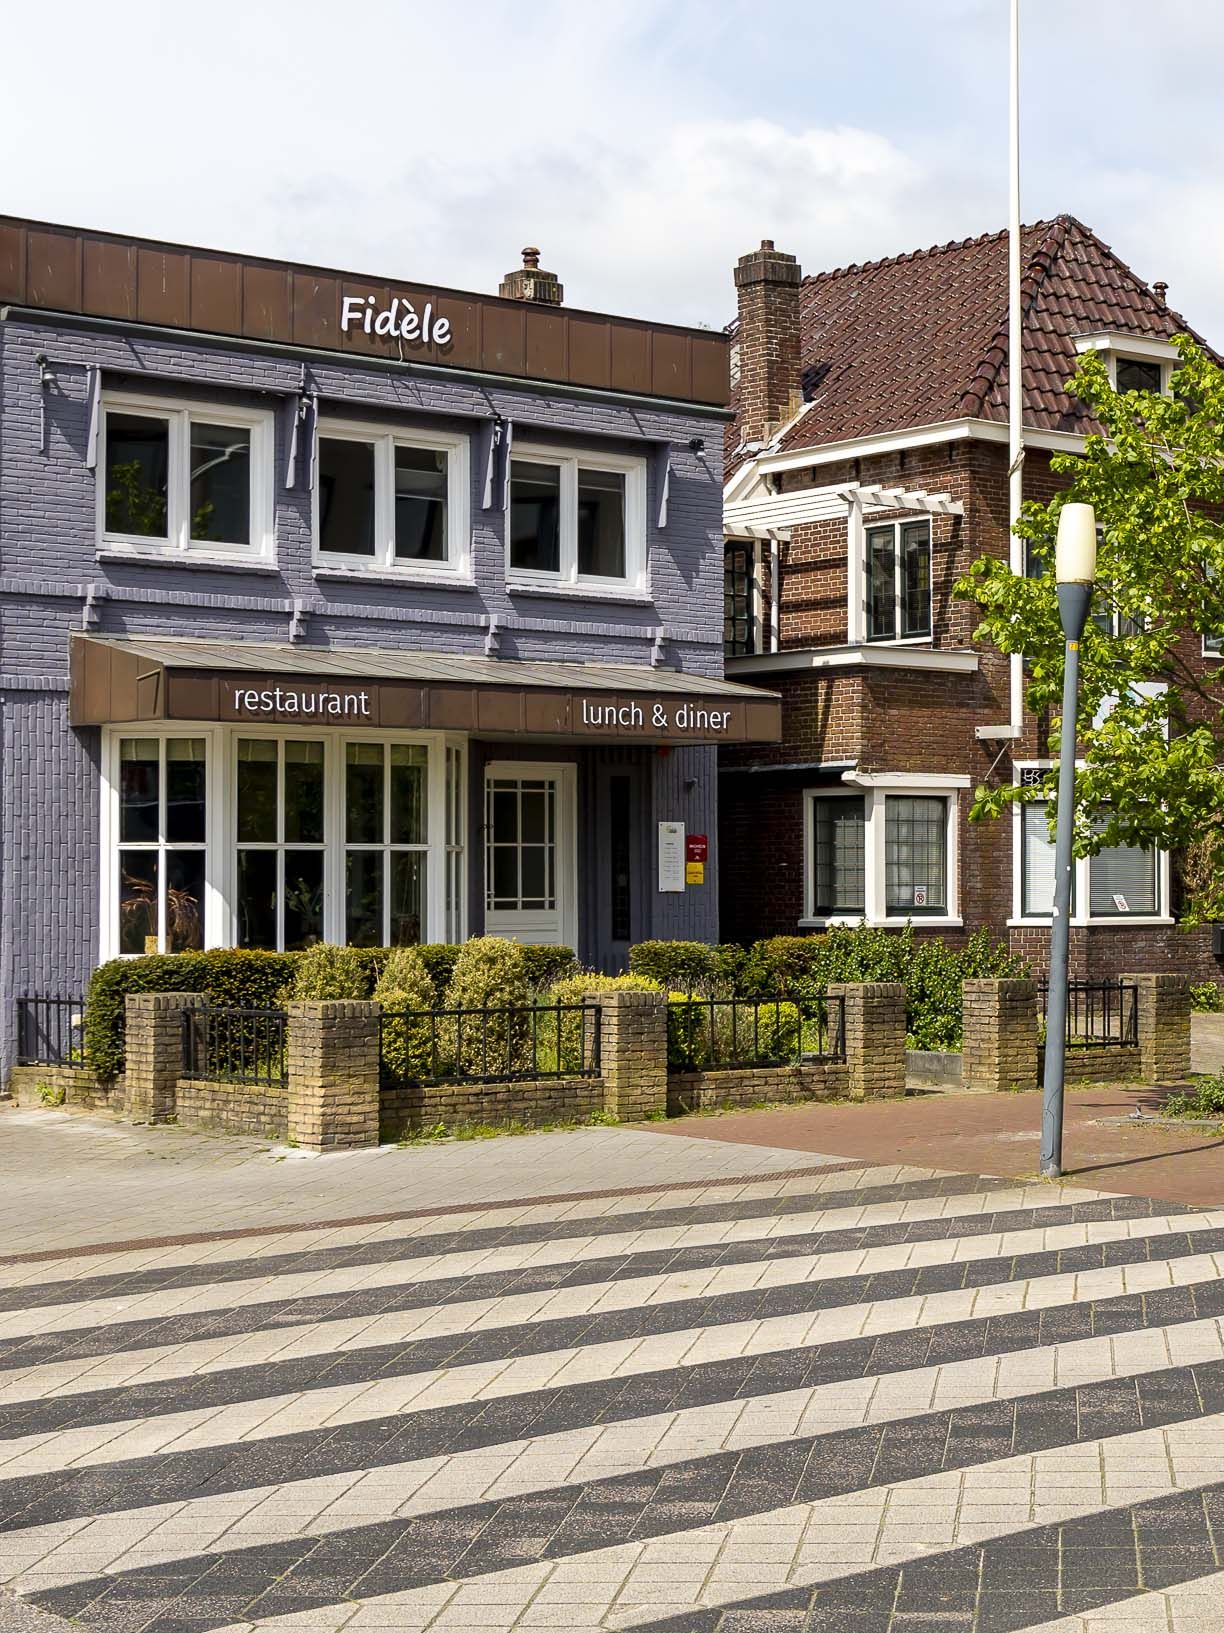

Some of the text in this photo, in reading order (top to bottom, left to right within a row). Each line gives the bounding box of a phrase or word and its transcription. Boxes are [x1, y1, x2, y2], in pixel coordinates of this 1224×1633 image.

[341, 296, 451, 344] Fidèle
[234, 688, 370, 714] restaurant
[582, 699, 731, 729] lunch & diner
